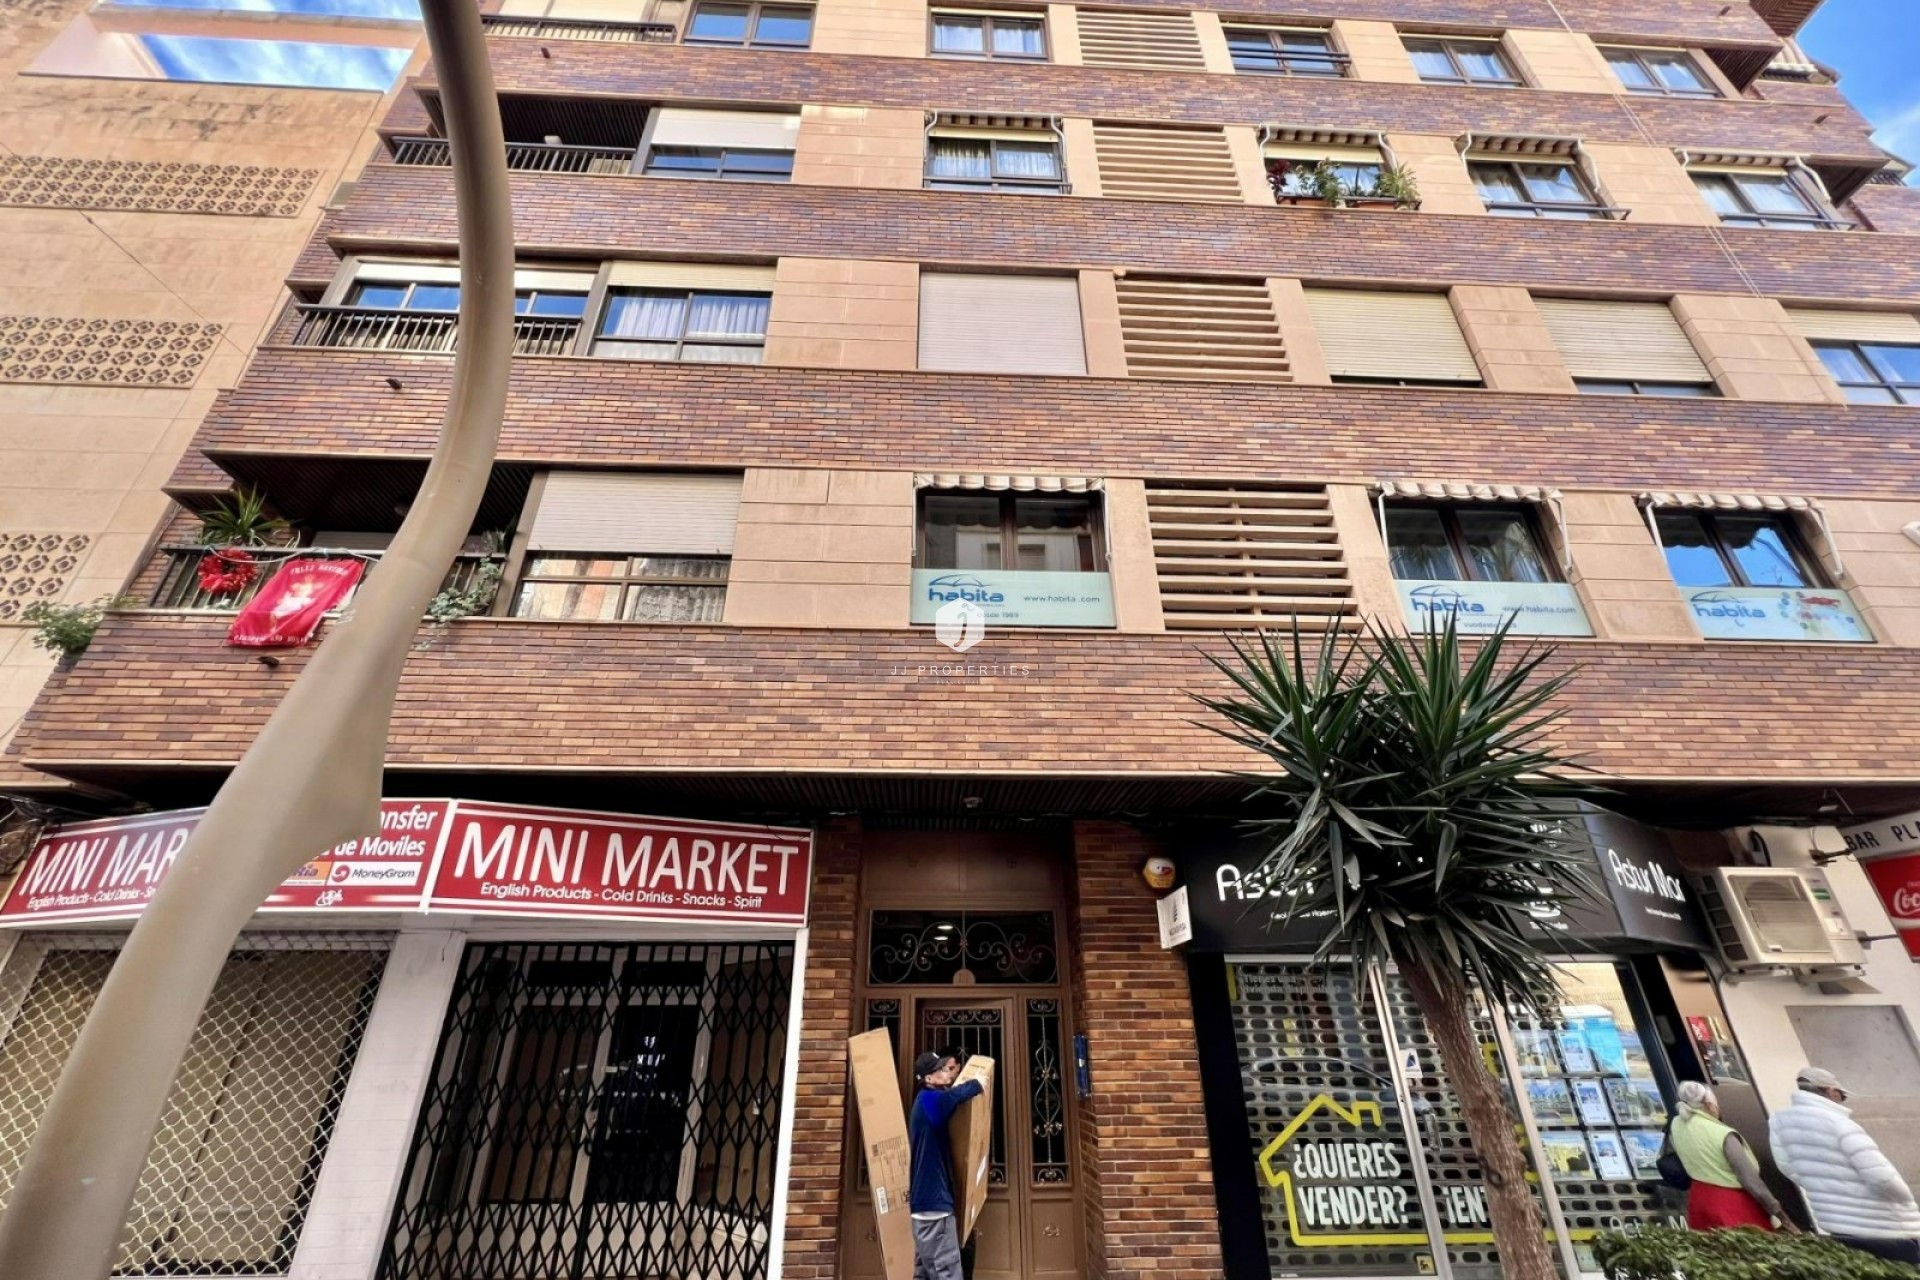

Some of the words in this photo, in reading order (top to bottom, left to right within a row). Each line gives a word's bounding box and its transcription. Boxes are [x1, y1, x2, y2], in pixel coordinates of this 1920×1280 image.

[928, 587, 1005, 604] habita
[1411, 598, 1485, 613] habita
[1693, 604, 1767, 618] habita
[380, 804, 439, 830] nsfer
[360, 835, 427, 856] Moviles
[1843, 831, 1880, 851] BAR
[18, 837, 110, 896] MINI
[98, 828, 190, 888] MAR
[454, 822, 590, 885] MINI
[600, 833, 799, 896] MARKET
[351, 868, 415, 880] MoneyGram
[1608, 849, 1655, 894] Astur
[27, 894, 56, 911] English
[55, 892, 88, 907] Products
[93, 889, 115, 904] Cold
[113, 888, 140, 900] Drinks
[481, 882, 530, 899] English
[533, 885, 592, 900] Products
[601, 888, 633, 902] Cold
[636, 890, 673, 904] Drinks
[682, 892, 726, 907] Snacks
[734, 895, 763, 910] Spirit
[1293, 1142, 1401, 1179] ¿QUIERES
[1298, 1186, 1409, 1226] VENDER?
[1441, 1186, 1488, 1224] ¡EN
